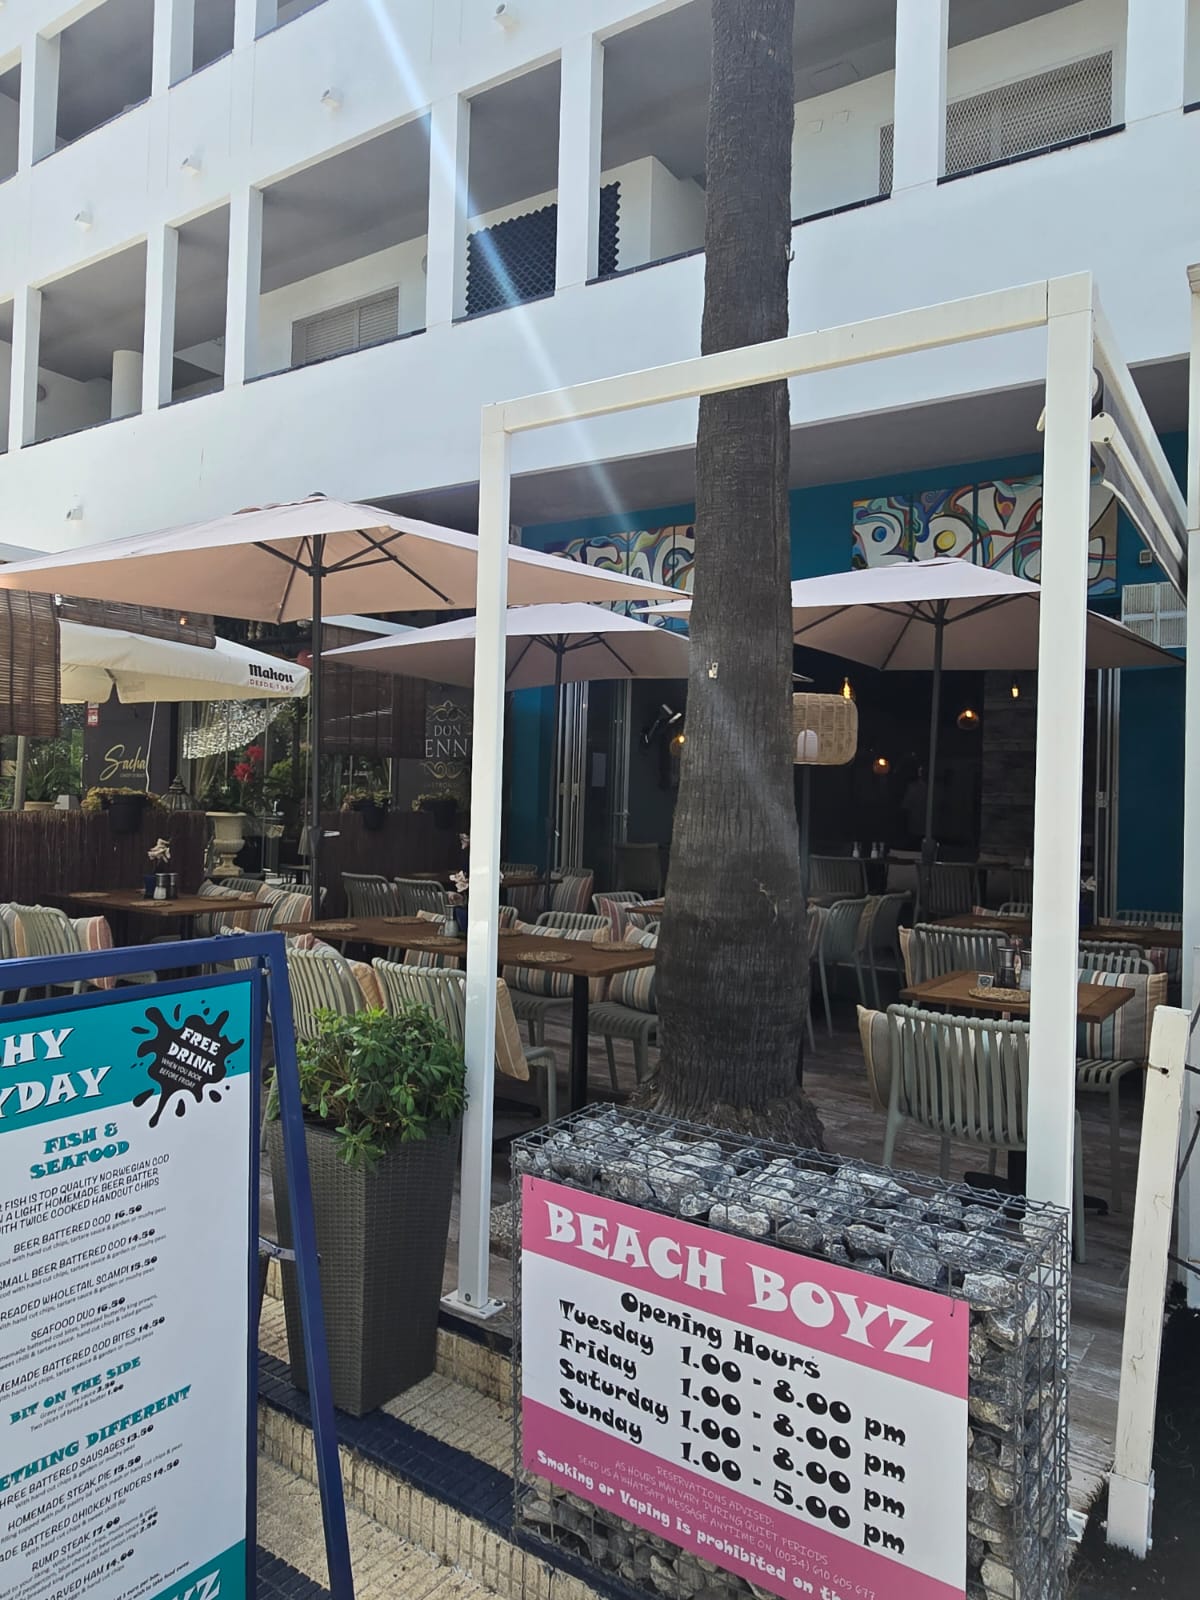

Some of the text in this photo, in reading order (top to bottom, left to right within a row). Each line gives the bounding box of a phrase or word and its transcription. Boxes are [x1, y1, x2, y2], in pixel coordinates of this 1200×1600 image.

[248, 663, 294, 683] Mahou
[249, 679, 274, 689] DESDE
[434, 724, 461, 737] DON
[100, 744, 146, 781] Sacha
[1, 1027, 75, 1068] HY
[167, 1041, 217, 1076] DRINK
[180, 1027, 221, 1056] FREE
[159, 1067, 196, 1089] BEFORE FRIDAY
[161, 1057, 203, 1082] WHEN YOU BOOK
[30, 1141, 130, 1179] SEAFOOD
[43, 1122, 118, 1155] FISH &
[0, 1177, 159, 1235] ITH TWICE COOKED HANDCUT CHIPS
[5, 1153, 170, 1211] FISH IS TOP QUALITY NORWEGIAN COD
[5, 1167, 158, 1222] A LIGHT HOMEMADE BEER BATTER
[12, 1254, 25, 1262] with
[26, 1248, 41, 1258] hand
[42, 1245, 52, 1253] cut
[70, 1233, 89, 1243] tartare
[90, 1227, 106, 1236] sauce
[112, 1219, 130, 1230] garden
[13, 1205, 142, 1254] BEER BATTERED COD 16.50
[31, 1262, 57, 1279] BEER
[59, 1244, 107, 1269] BATTERED
[108, 1237, 127, 1252] COD
[128, 1229, 155, 1244] 14.50
[42, 1279, 94, 1306] WHOLETAIL
[96, 1265, 129, 1285] SCAMPI
[131, 1256, 158, 1272] 15.50
[543, 1200, 934, 1363] BEACH BOYZ
[31, 1297, 126, 1341] SEAFOOD DUO 16.50
[42, 1346, 91, 1375] BATTERED
[92, 1338, 111, 1353] COD
[112, 1327, 136, 1345] BITES
[139, 1316, 165, 1333] 14.50
[621, 1292, 821, 1379] Opening Hours
[10, 1356, 141, 1425] BIT ON THE SIDE
[559, 1299, 906, 1447] Tuesday 1.00 8.00 pm
[40, 1408, 57, 1419] Gravy
[65, 1398, 80, 1408] curry
[81, 1390, 96, 1401] sauce
[86, 1384, 191, 1449] DIFFERENT
[559, 1329, 905, 1483] Friday 1.00 8.00 pm
[29, 1461, 78, 1494] BATTERED
[80, 1437, 125, 1468] SAUSAGES
[127, 1424, 154, 1443] 13.50
[559, 1358, 905, 1519] Saturday 1.00 8.00 pm
[8, 1455, 141, 1532] HOMEMADE STEAK PIE 15.50
[559, 1387, 904, 1555] Sunday 1.00 5.00 pm
[656, 1466, 727, 1505] RESERVATIONS
[20, 1517, 71, 1552] BATTERED
[72, 1494, 111, 1523] CHICKEN
[113, 1472, 152, 1500] TENDERS
[154, 1459, 179, 1478] 14.50
[537, 1450, 594, 1490] Smoking
[599, 1483, 615, 1496] or
[620, 1489, 670, 1527] Vaping
[676, 1517, 691, 1535] is
[697, 1530, 786, 1582] prohibited
[793, 1577, 813, 1594] on
[578, 1454, 599, 1470] SEND
[601, 1465, 612, 1477] US
[613, 1471, 619, 1481] A
[667, 1496, 707, 1522] MESSAGE
[710, 1517, 755, 1545] ANYTIME
[757, 1539, 772, 1553] ON
[775, 1547, 810, 1571] (0034)
[833, 1574, 852, 1590] 605
[855, 1585, 875, 1600] 677
[615, 1460, 828, 1565] AS HOURS MAY VARY DURING QUIET PERIODS
[32, 1516, 120, 1572] RUMP STEAK 17.00
[50, 1578, 82, 1600] ARVED
[83, 1564, 104, 1584] HAM
[106, 1548, 134, 1570] 14.00
